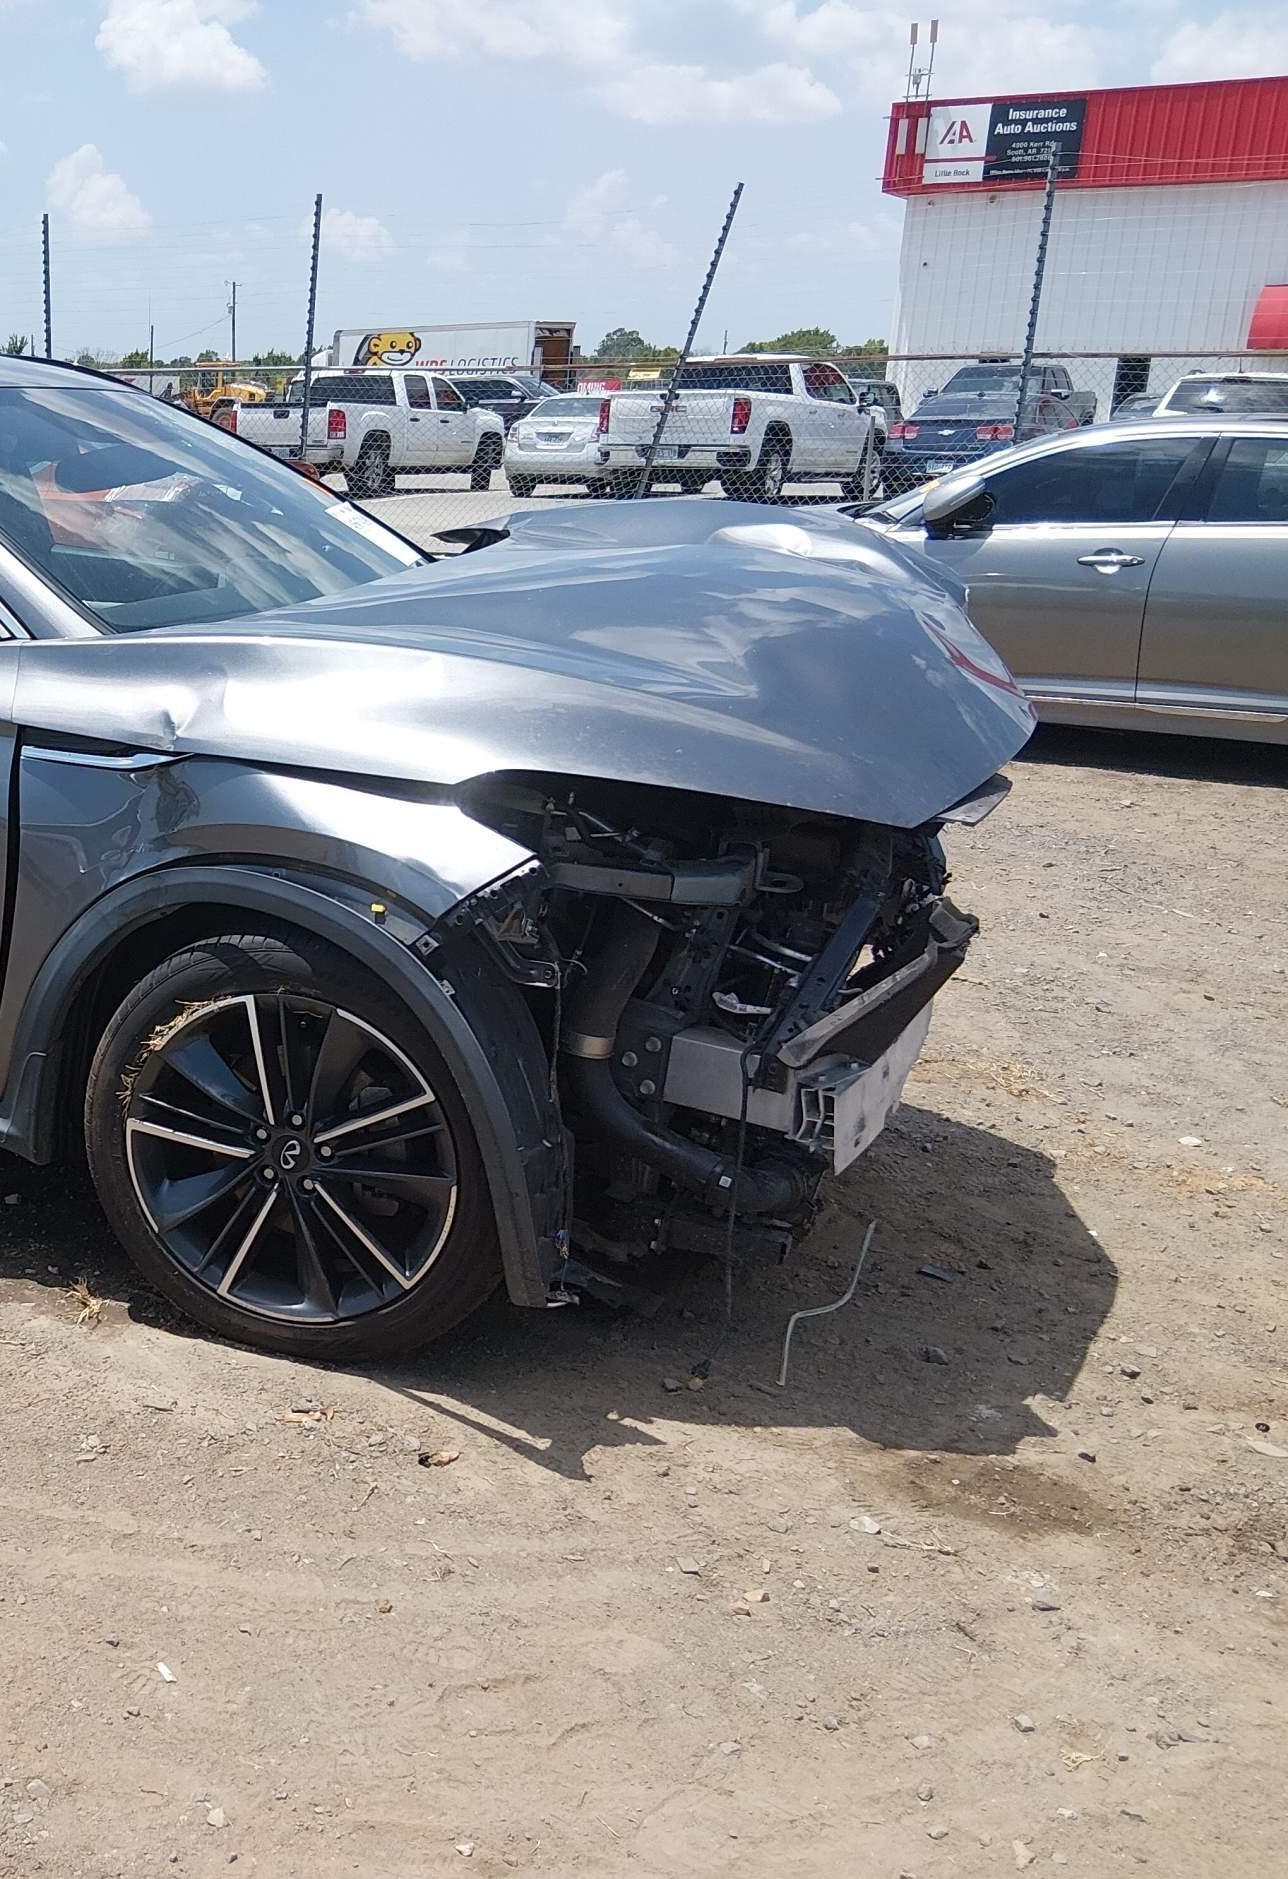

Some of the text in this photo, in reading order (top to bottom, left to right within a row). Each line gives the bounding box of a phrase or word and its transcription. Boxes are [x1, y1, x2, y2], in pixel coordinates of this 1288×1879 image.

[1008, 108, 1067, 120] Insurance
[994, 120, 1078, 135] Auto Auctions
[449, 356, 519, 376] LOGISTICS
